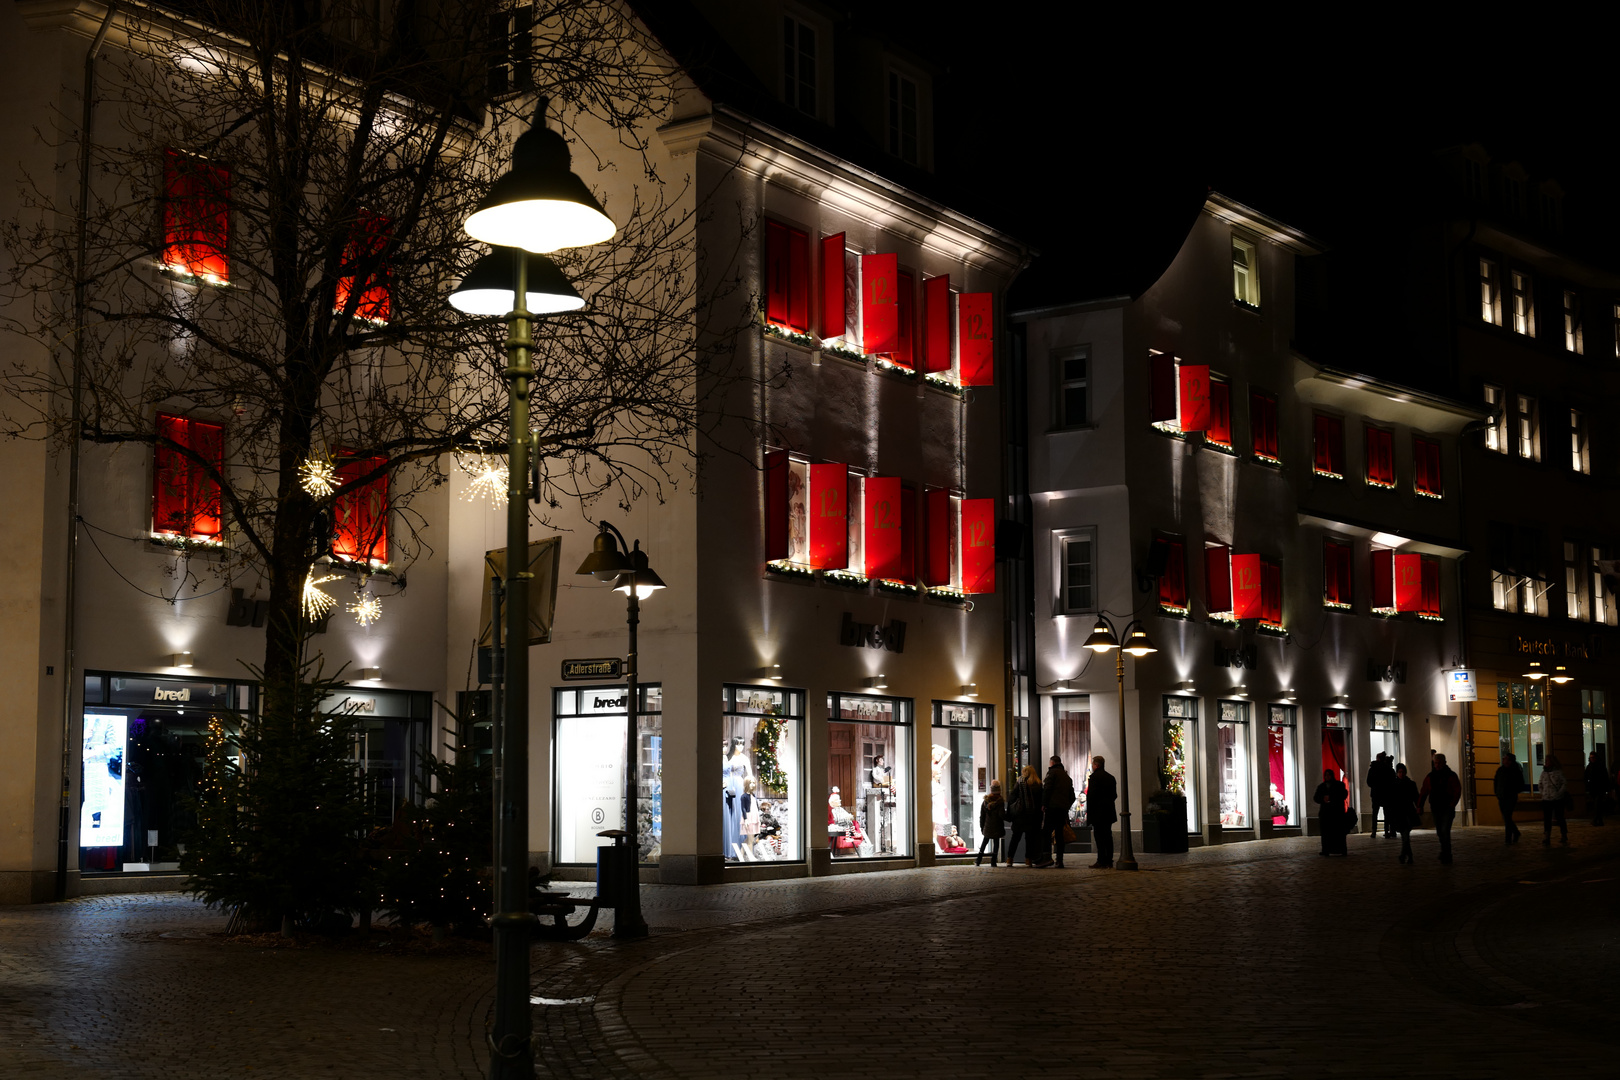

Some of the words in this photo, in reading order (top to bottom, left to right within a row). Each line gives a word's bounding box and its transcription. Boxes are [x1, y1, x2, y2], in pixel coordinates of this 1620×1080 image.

[869, 277, 892, 305] 12.
[967, 314, 988, 340] 12.
[819, 487, 843, 518] 12.
[873, 501, 896, 530] 12.
[969, 520, 990, 548] 12.
[840, 612, 907, 654] bredl
[1214, 640, 1257, 670] bredl
[1564, 641, 1589, 659] Bank
[570, 662, 612, 675] Adlerstraße
[1367, 658, 1407, 684] bredl
[154, 686, 191, 702] bredl
[345, 698, 376, 712] bredl
[594, 696, 628, 708] bredl
[748, 696, 773, 710] bredl
[857, 704, 878, 717] bredl
[951, 709, 969, 723] bredl
